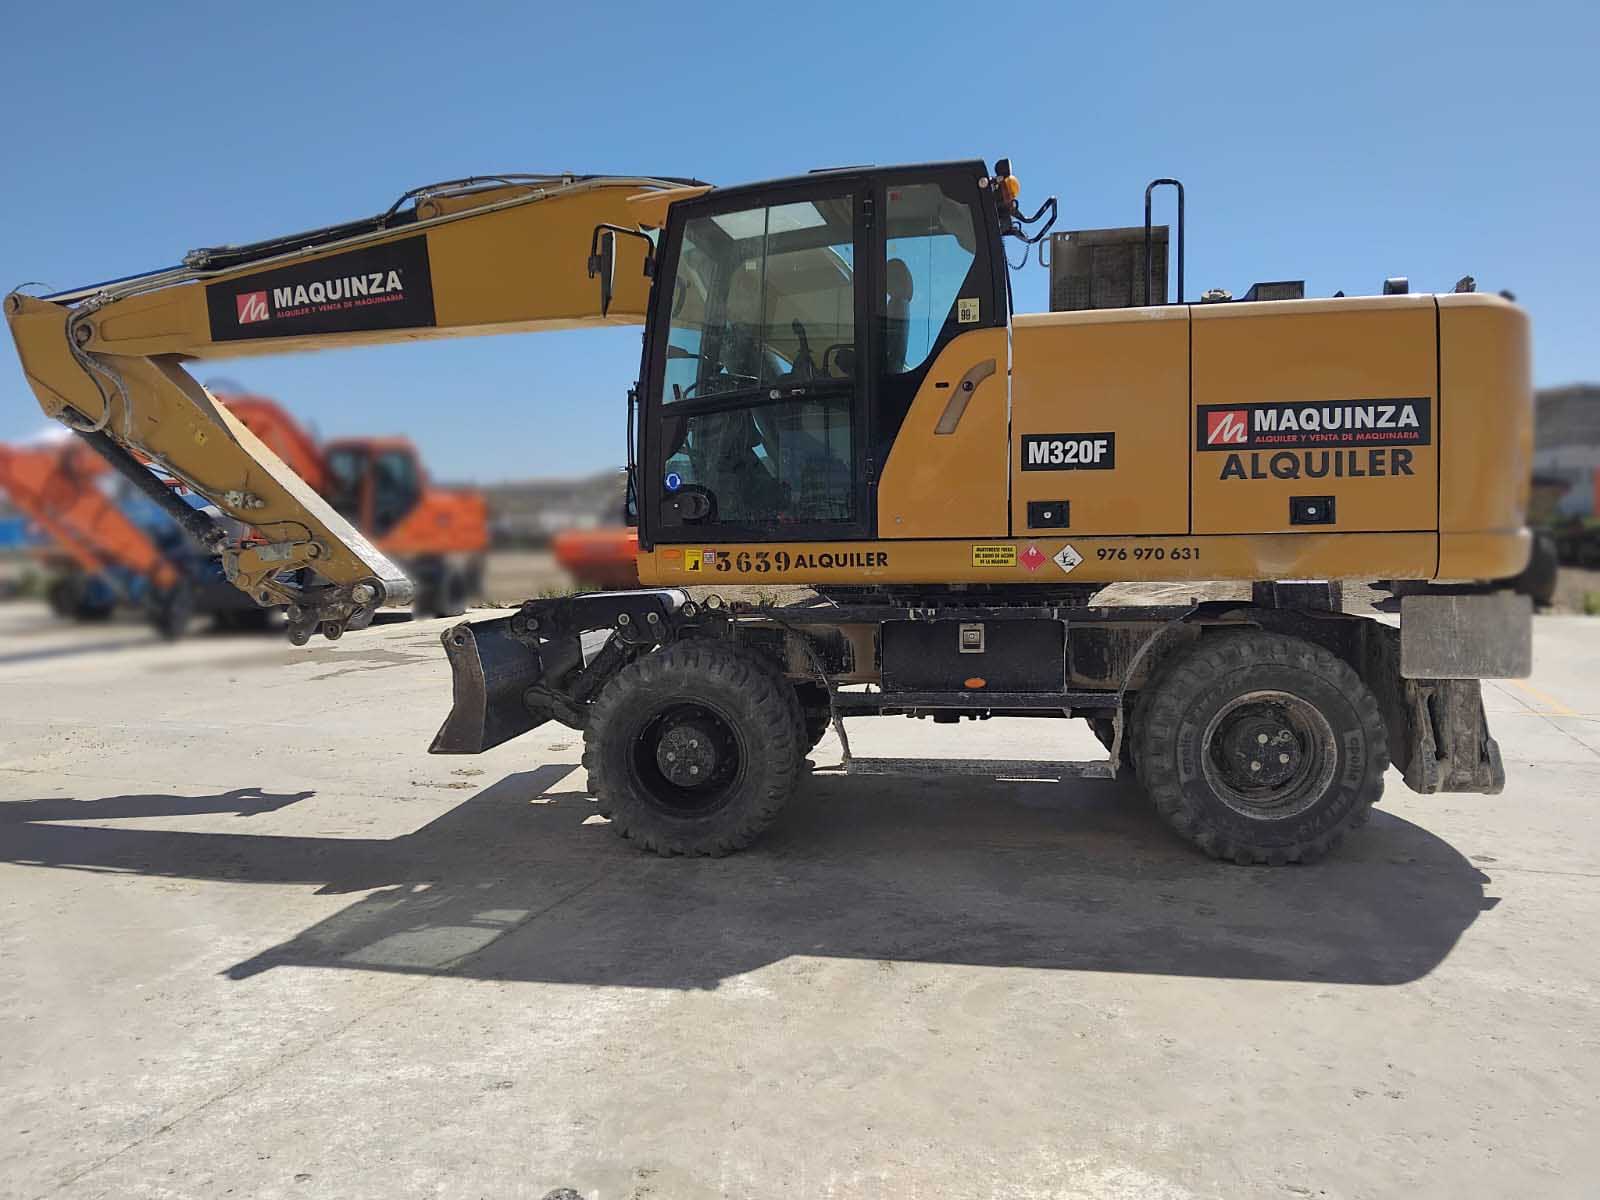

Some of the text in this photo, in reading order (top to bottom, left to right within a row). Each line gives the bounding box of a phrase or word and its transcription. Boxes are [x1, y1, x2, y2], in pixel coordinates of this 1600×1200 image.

[273, 270, 403, 309] MAQUINZA
[276, 308, 310, 318] ALQUILER
[319, 302, 342, 312] VENTA
[343, 300, 353, 308] DE
[355, 294, 404, 306] MAQUINARIA
[1253, 404, 1420, 432] MAQUINZA
[1255, 434, 1297, 443] ALQUILER
[1309, 432, 1338, 441] VENTA
[1342, 432, 1353, 440] DE
[1356, 431, 1420, 440] MAQUINARIA
[1028, 439, 1108, 464] M320F
[1219, 448, 1415, 480] ALQUILER
[794, 551, 889, 569] ALQUILER
[1096, 547, 1200, 561] 976 970 631
